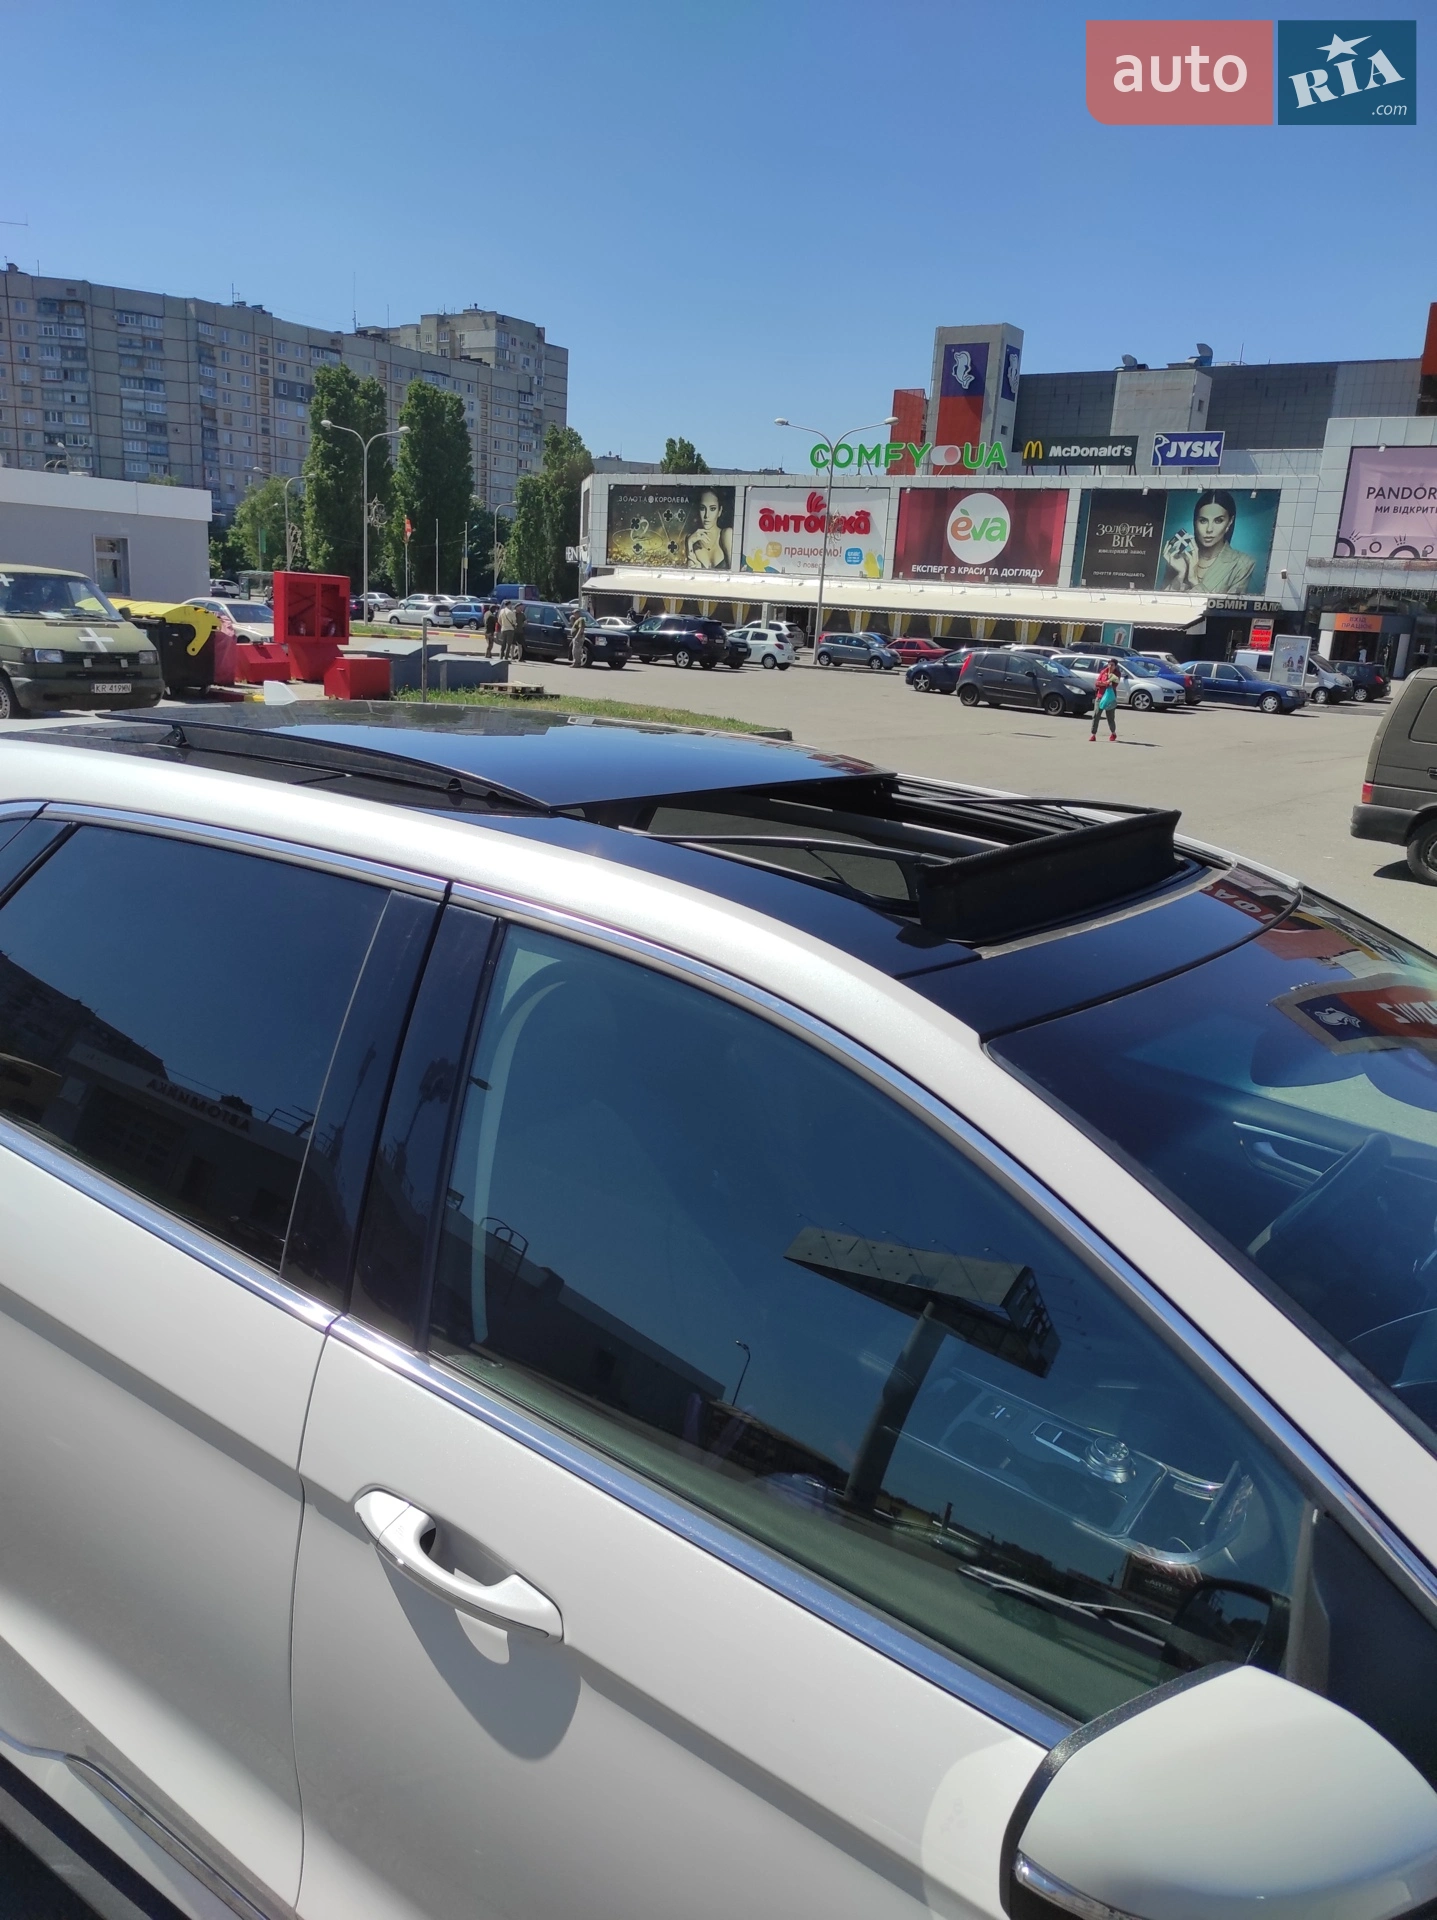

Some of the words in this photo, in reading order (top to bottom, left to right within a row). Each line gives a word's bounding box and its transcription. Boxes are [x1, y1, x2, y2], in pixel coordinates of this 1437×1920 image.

[809, 442, 932, 469] COMFY
[962, 441, 1007, 469] UA
[1049, 445, 1133, 457] McDonald's
[1166, 440, 1221, 458] JYSK
[1374, 505, 1391, 514] МИ
[911, 565, 948, 574] ЕКСПЕРТ
[957, 566, 987, 576] КРАСИ
[988, 567, 999, 576] ТА
[1000, 568, 1043, 578] ДОГЛЯДУ
[1207, 599, 1248, 611] ОБМІН
